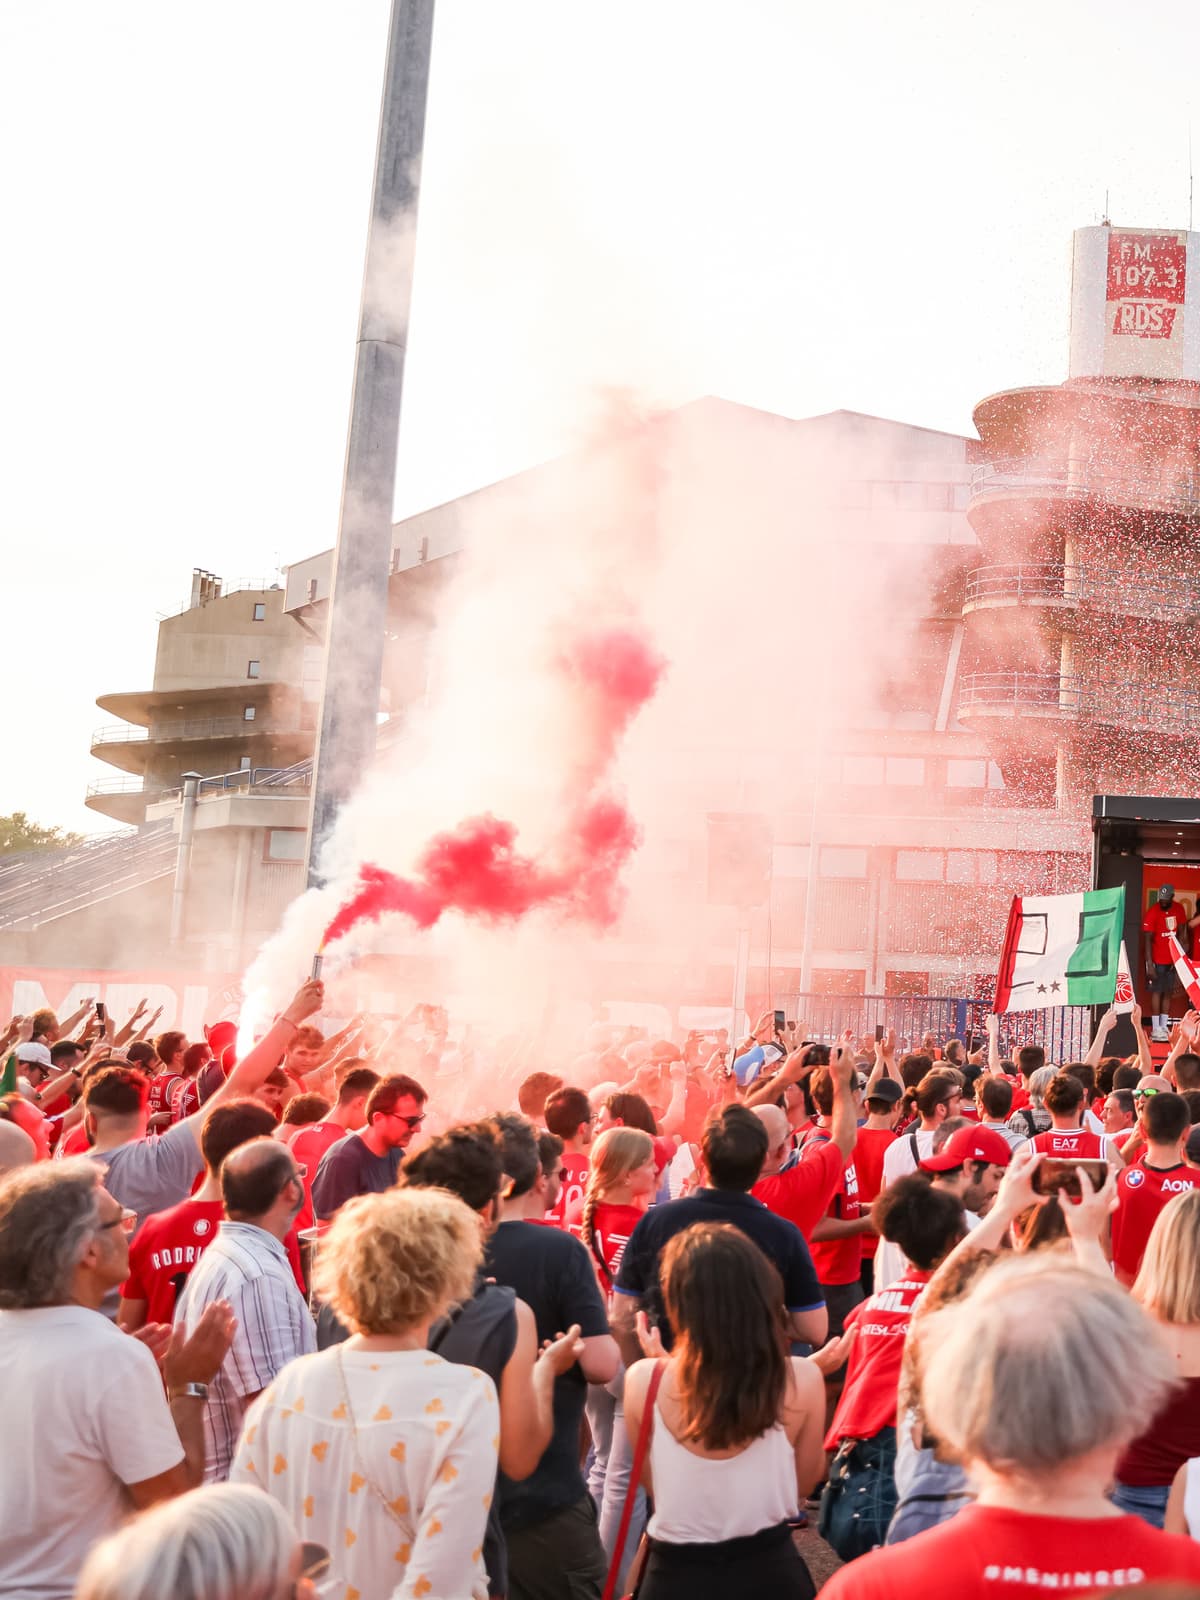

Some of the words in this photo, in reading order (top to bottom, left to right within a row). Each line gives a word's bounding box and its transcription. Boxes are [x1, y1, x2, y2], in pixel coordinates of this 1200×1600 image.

[1120, 242, 1151, 261] FM
[1113, 265, 1178, 288] 107.3
[1120, 304, 1164, 331] RDS
[1053, 1138, 1079, 1149] EA7
[1161, 1179, 1194, 1192] AON
